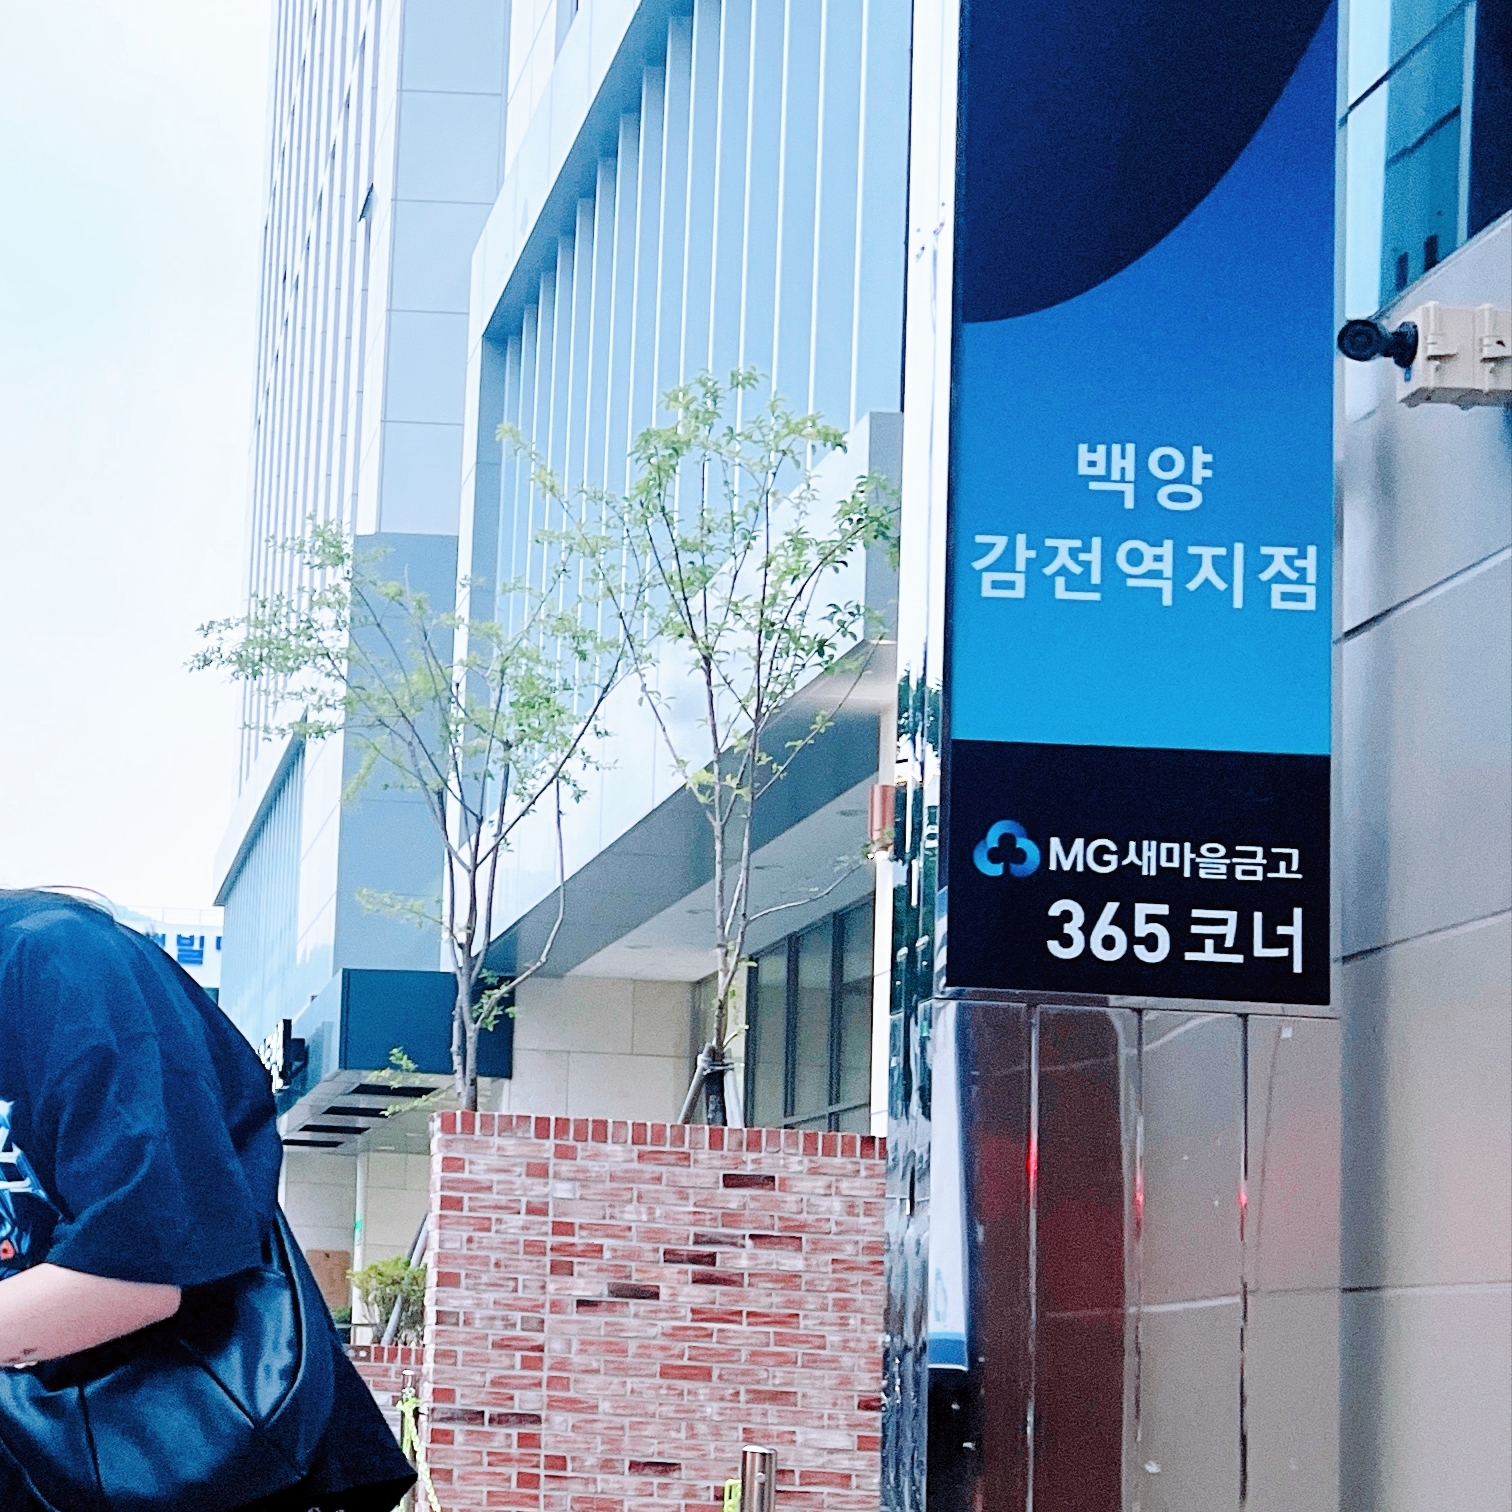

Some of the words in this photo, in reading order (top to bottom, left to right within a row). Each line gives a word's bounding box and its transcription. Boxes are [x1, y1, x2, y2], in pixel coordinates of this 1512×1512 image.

[1078, 443, 1213, 511] 백양
[973, 533, 1317, 611] 감전역지점
[1048, 836, 1303, 881] MG새마을금고
[1046, 899, 1171, 964] 365
[1184, 907, 1303, 974] 코너
